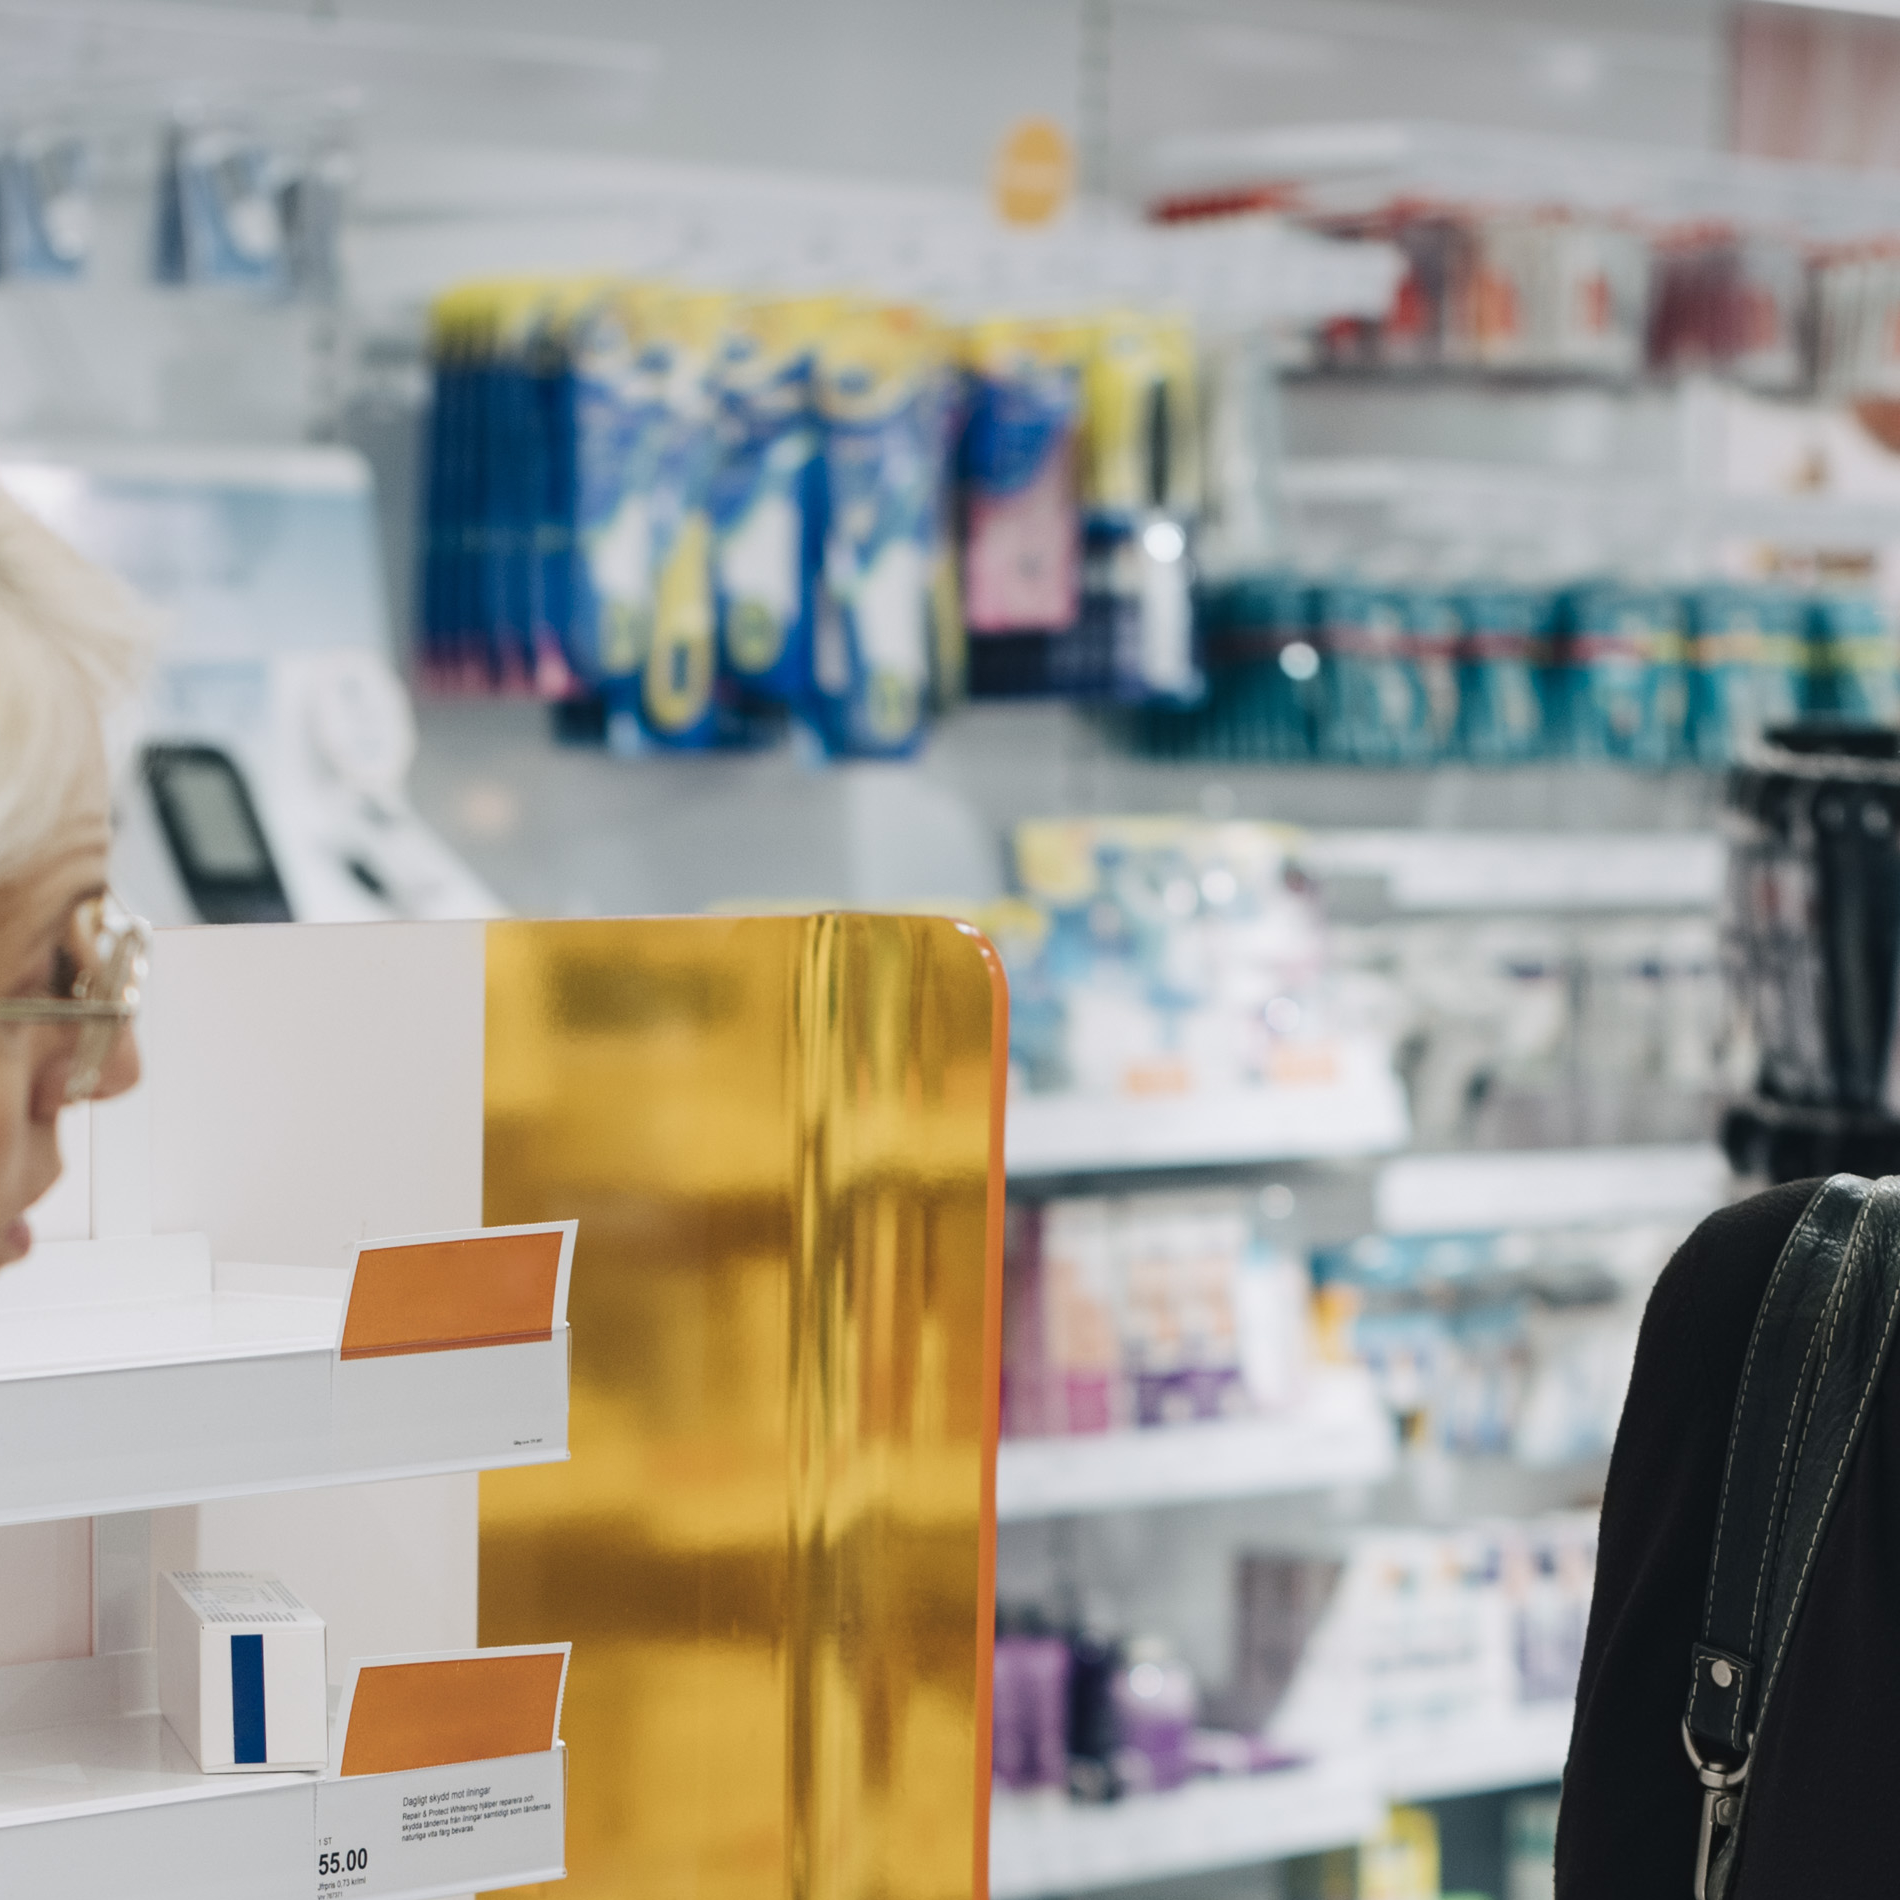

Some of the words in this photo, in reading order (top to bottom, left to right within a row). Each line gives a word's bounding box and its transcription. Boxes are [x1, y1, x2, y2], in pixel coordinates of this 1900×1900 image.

[402, 1795, 428, 1808] Dagligt
[429, 1791, 450, 1804] skydd
[451, 1790, 465, 1800] mot
[466, 1786, 491, 1799] ilningar
[402, 1812, 421, 1822] Repair
[428, 1807, 449, 1817] Protect
[450, 1803, 478, 1814] Whitening
[498, 1797, 522, 1808] reparera
[523, 1794, 535, 1803] och
[402, 1822, 422, 1832] skydda
[449, 1815, 461, 1825] från
[462, 1813, 482, 1823] ilningar
[483, 1808, 509, 1820] samtidigt
[510, 1808, 522, 1816] som
[323, 1836, 333, 1846] ST
[402, 1831, 426, 1842] naturliga
[427, 1829, 438, 1838] vita
[451, 1824, 475, 1835] bevaras.
[318, 1847, 368, 1876] 55.00
[317, 1882, 336, 1892] Jfrpris
[336, 1878, 351, 1889] 0,73
